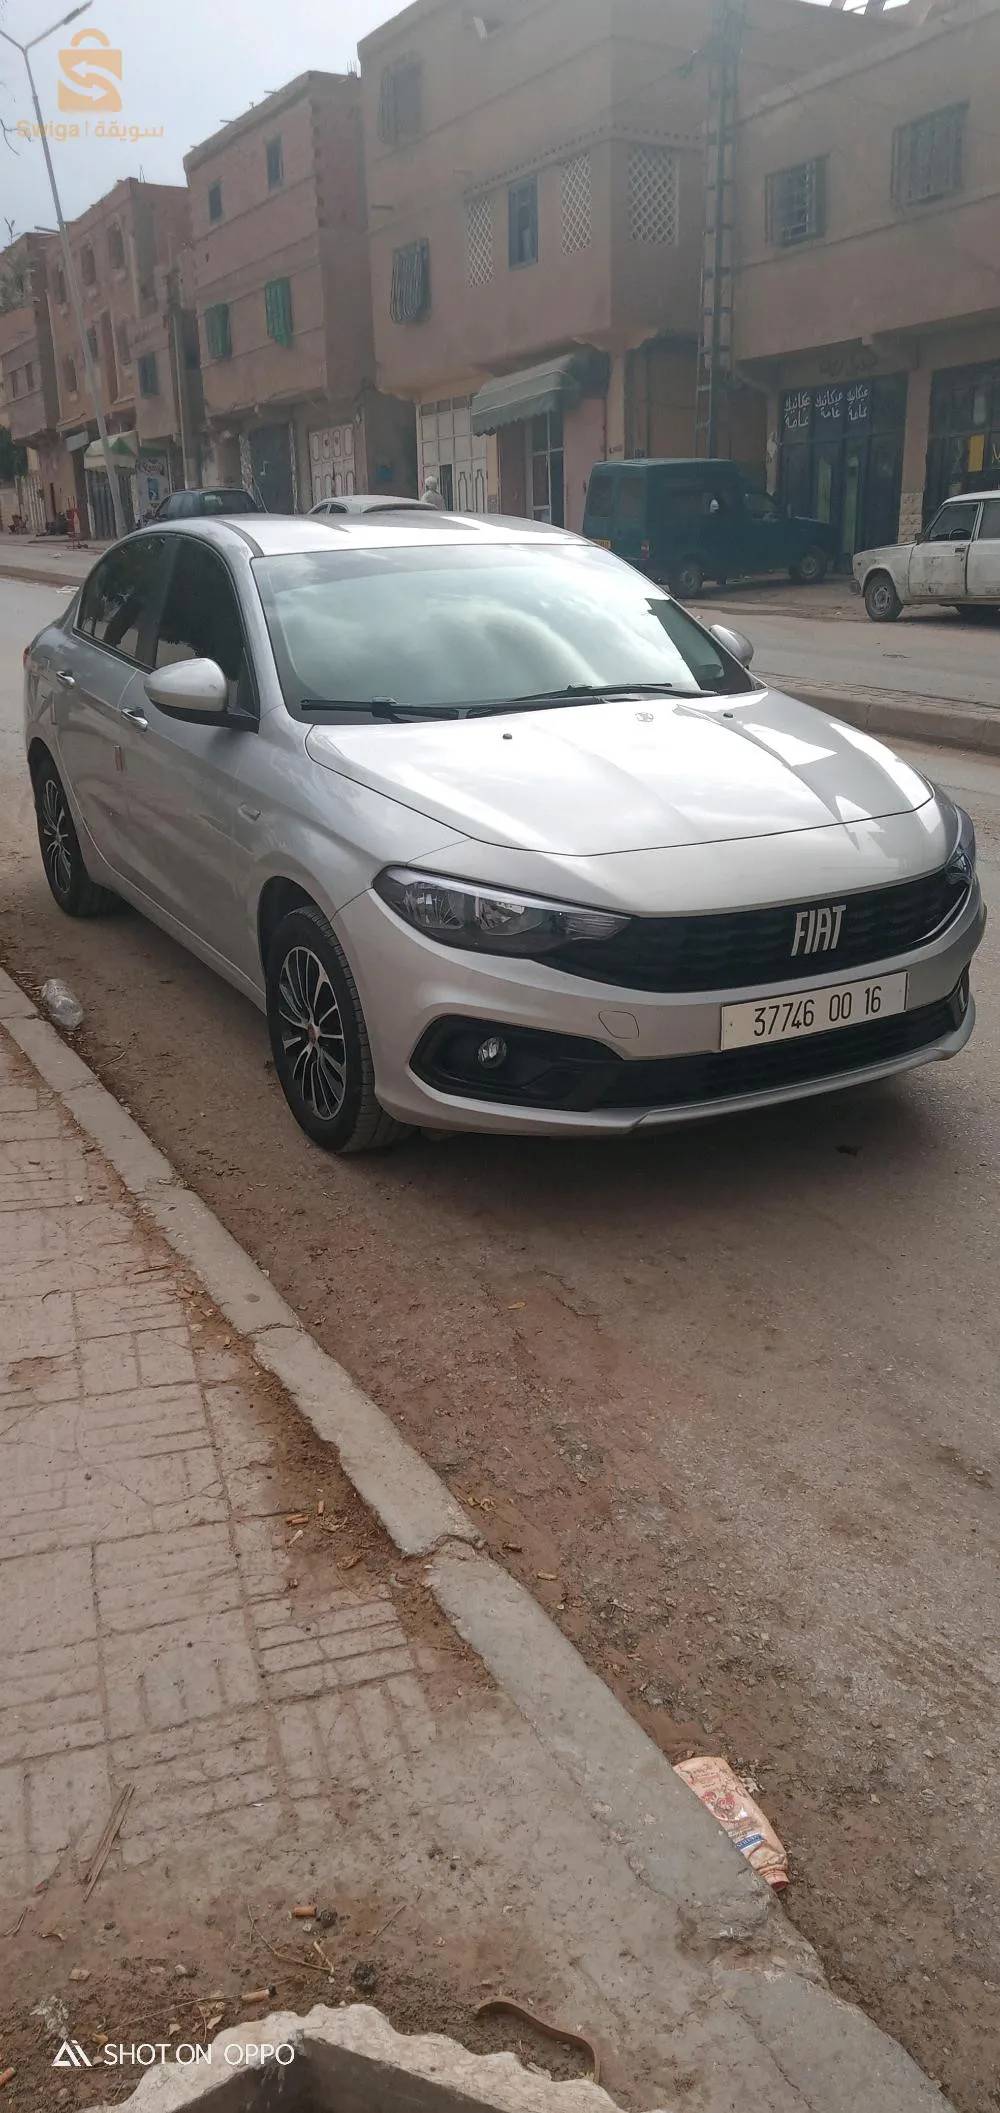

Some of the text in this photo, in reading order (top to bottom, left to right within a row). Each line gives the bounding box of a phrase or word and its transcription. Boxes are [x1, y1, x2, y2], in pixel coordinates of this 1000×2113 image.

[790, 904, 847, 957] FIAT
[753, 985, 882, 1037] 37746 00 16
